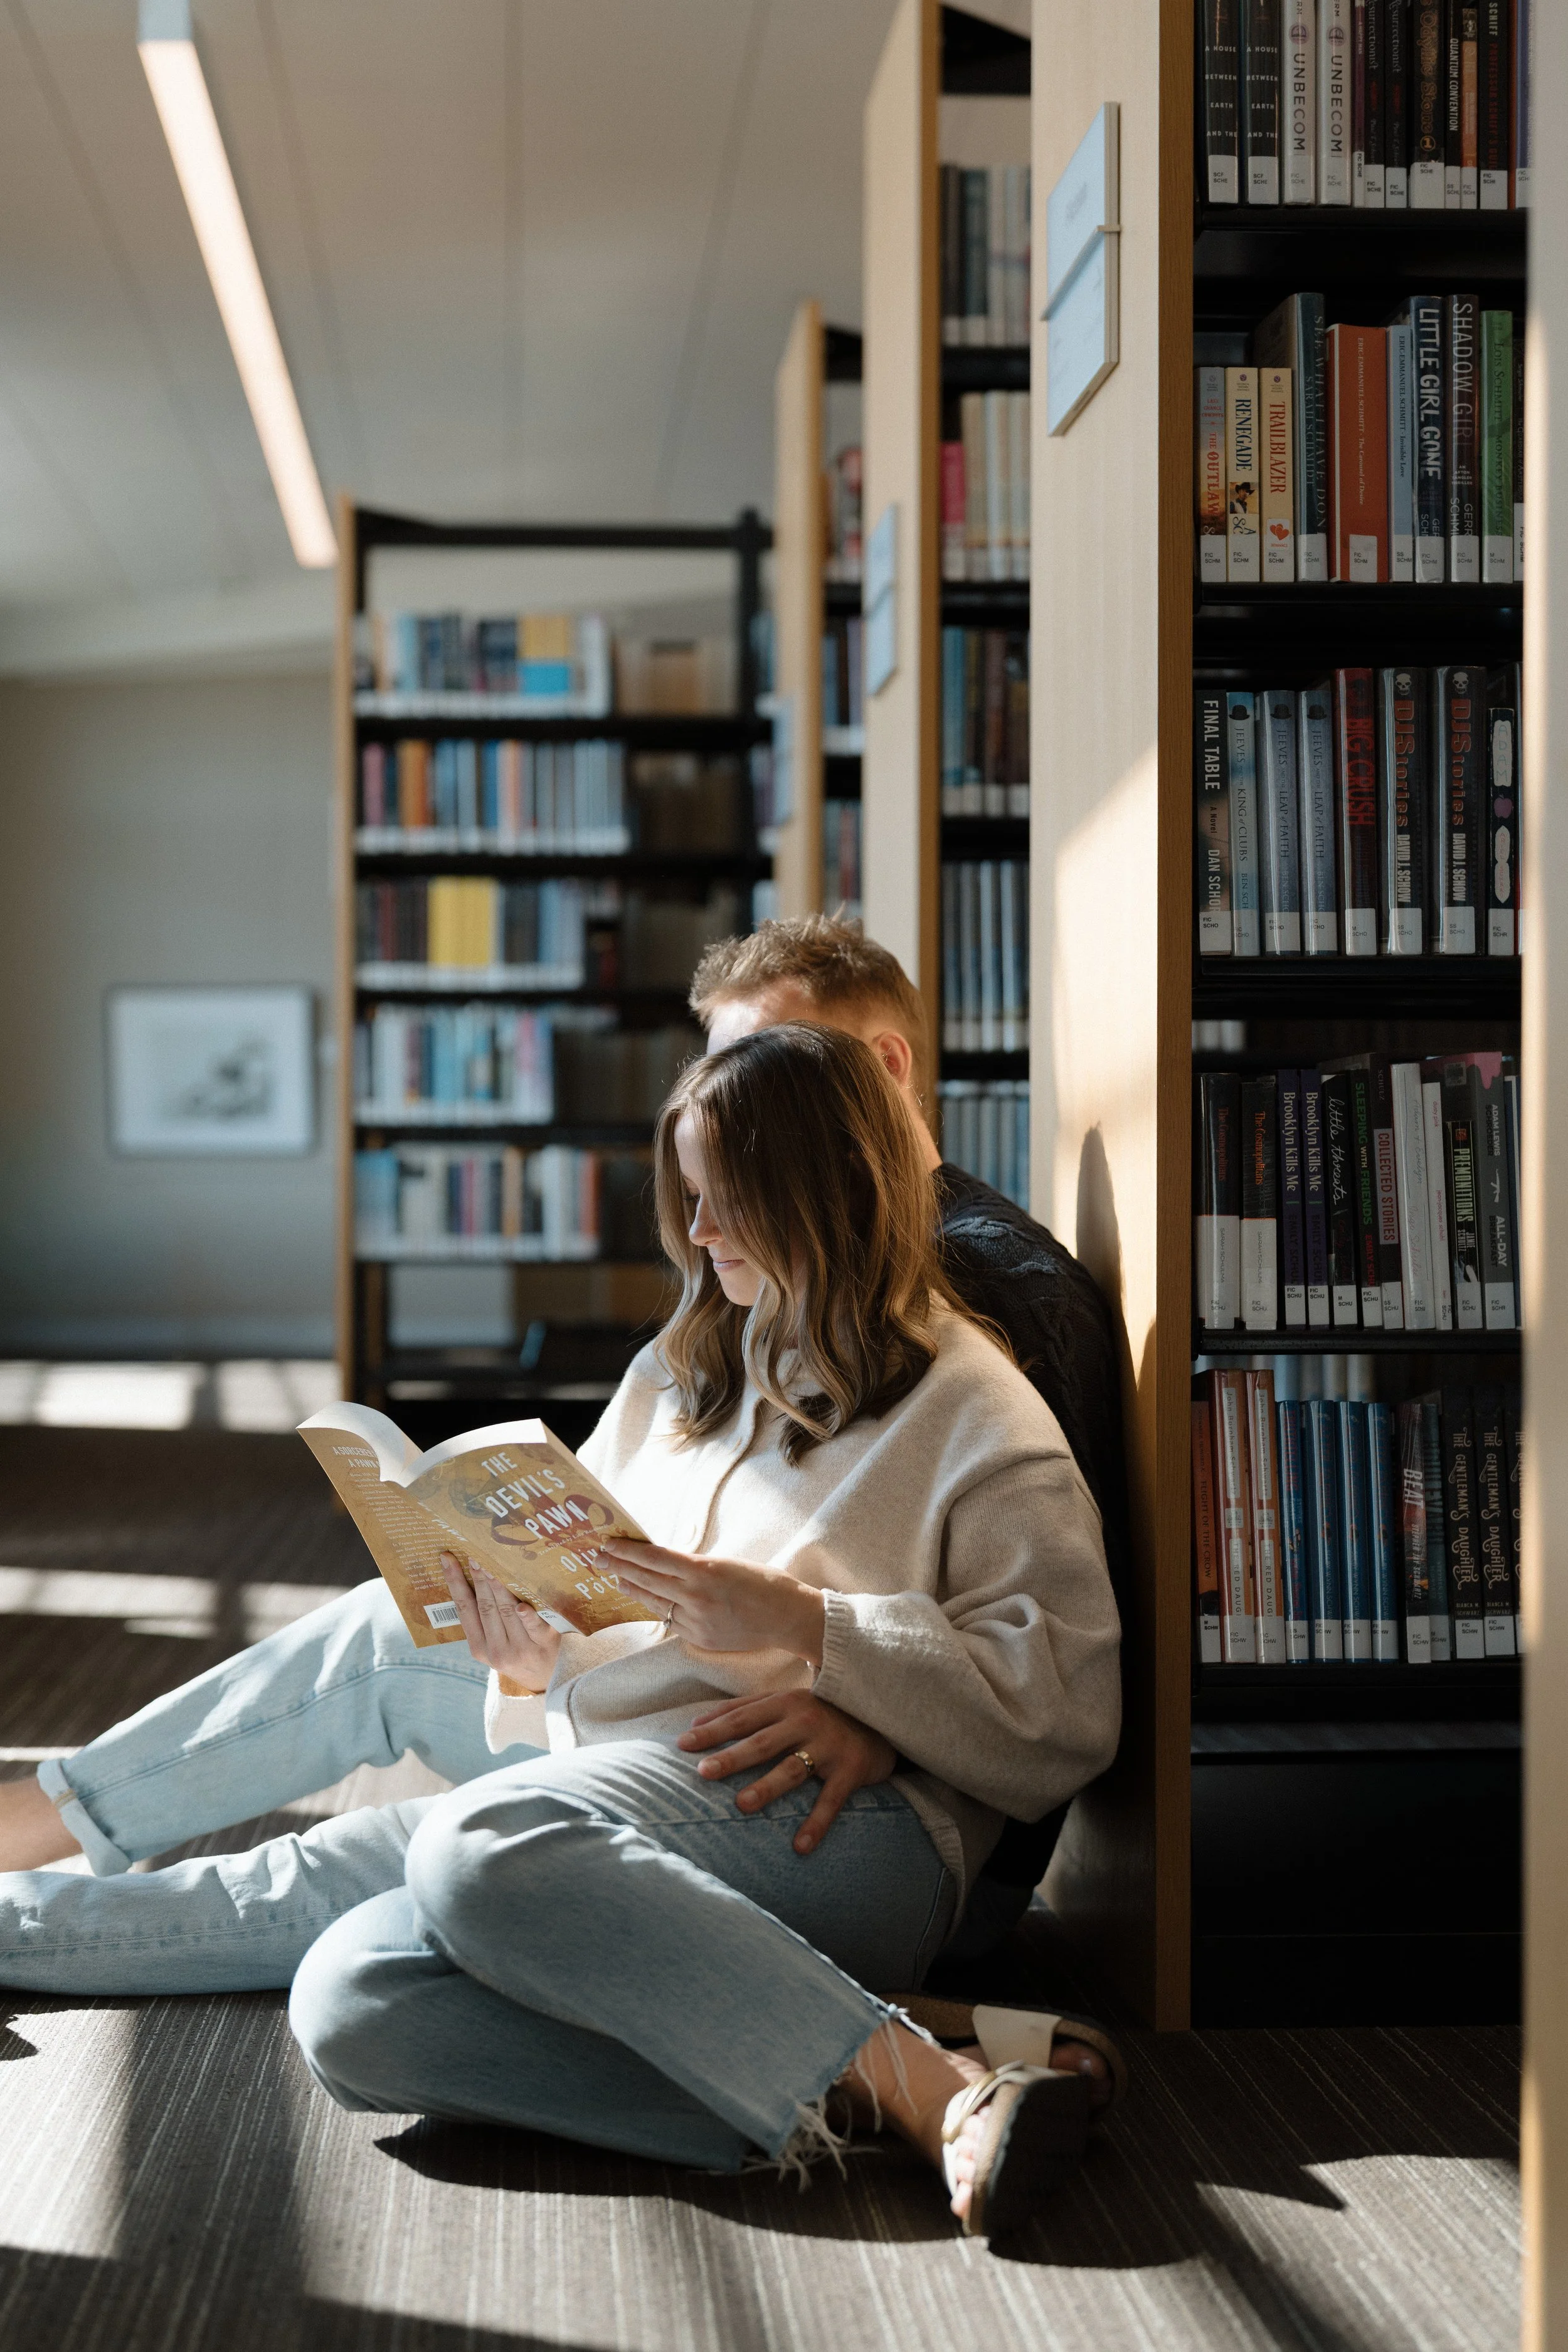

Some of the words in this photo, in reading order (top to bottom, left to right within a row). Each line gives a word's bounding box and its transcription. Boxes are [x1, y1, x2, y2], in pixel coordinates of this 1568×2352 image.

[1488, 3, 1497, 36] SCHIFF
[1449, 38, 1458, 78] QUANTUM
[1449, 80, 1459, 131] CONVENTION
[1419, 309, 1440, 369] LITTLE
[1453, 303, 1473, 393] SHADOW
[1493, 342, 1505, 366] LOIS
[1305, 376, 1314, 420] SARAH
[1419, 374, 1440, 421] GIRL
[1493, 371, 1505, 421] SCHMITT
[1235, 398, 1252, 471] RENEGADE
[1269, 401, 1286, 493] TRAILBLAZER
[1419, 425, 1441, 480] GONE
[1306, 424, 1315, 487] SCHMIDT
[1207, 452, 1221, 514] OUTLAW
[1359, 477, 1365, 485] of
[1204, 700, 1220, 741] FINAL
[1346, 718, 1375, 753] BIG
[1234, 729, 1244, 763] JEEVES
[1277, 730, 1287, 765] JEEVES
[1312, 730, 1322, 766] JEEVES
[1394, 699, 1415, 827] DJStories
[1450, 699, 1471, 825] DJStories
[1204, 746, 1221, 790] TABLE
[1237, 788, 1246, 817] KING
[1279, 791, 1288, 814] LEAP
[1315, 792, 1323, 815] LEAP
[1346, 759, 1376, 825] CRUSH
[1238, 827, 1248, 862] CLUBS
[1280, 825, 1290, 858] FAITH
[1315, 825, 1325, 858] FAITH
[1397, 834, 1410, 861] DAVID
[1453, 833, 1466, 859] DAVID
[1208, 849, 1221, 871] DAN
[1397, 869, 1411, 902] SCHOW
[1453, 868, 1466, 901] SCHOW
[1218, 1108, 1229, 1123] The
[1254, 1111, 1266, 1126] The
[1281, 1091, 1297, 1145] Brooklyn
[1305, 1091, 1320, 1145] Brooklyn
[1328, 1096, 1345, 1140] little
[1214, 1124, 1229, 1182] Cosmopolitans
[1251, 1128, 1266, 1185] Cosmopolitans
[1285, 1147, 1298, 1173] Kills
[1308, 1147, 1321, 1173] Kills
[1355, 1083, 1367, 1144] SLEEPING
[1361, 1170, 1372, 1226] FRIENDS
[1377, 1133, 1392, 1192] COLLECTED
[1286, 1175, 1298, 1192] Me
[1308, 1175, 1321, 1192] Me
[1330, 1144, 1347, 1205] threats
[1453, 1148, 1474, 1222] PREMONITIONS
[1380, 1197, 1395, 1241] STORIES
[1436, 1189, 1444, 1223] jean-jacques
[1365, 1234, 1374, 1260] EMILY
[1456, 1229, 1466, 1252] SCHULTZ
[1465, 1232, 1476, 1248] JAMIE
[1489, 1214, 1498, 1267] BREAKFAST
[1495, 1216, 1507, 1267] ALL-DAY
[1453, 1426, 1471, 1448] THE
[1483, 1426, 1503, 1448] THE
[348, 1459, 356, 1468] A
[355, 1459, 376, 1468] PAWN
[481, 1452, 518, 1477] THE
[485, 1468, 565, 1518] DEVIL'S
[1402, 1468, 1423, 1509] BEAT
[1448, 1454, 1470, 1520] GENTLEMAN'S
[1479, 1453, 1502, 1520] GENTLEMAN'S
[524, 1500, 590, 1540] PAWN
[1202, 1515, 1209, 1527] OF
[1411, 1523, 1421, 1552] STEPHEN
[1204, 1550, 1212, 1578] CROW
[1411, 1554, 1421, 1566] JAY
[1451, 1527, 1479, 1591] DAUGHTER
[1482, 1526, 1510, 1589] DAUGHTER
[1412, 1566, 1422, 1599] SCHWARTZ
